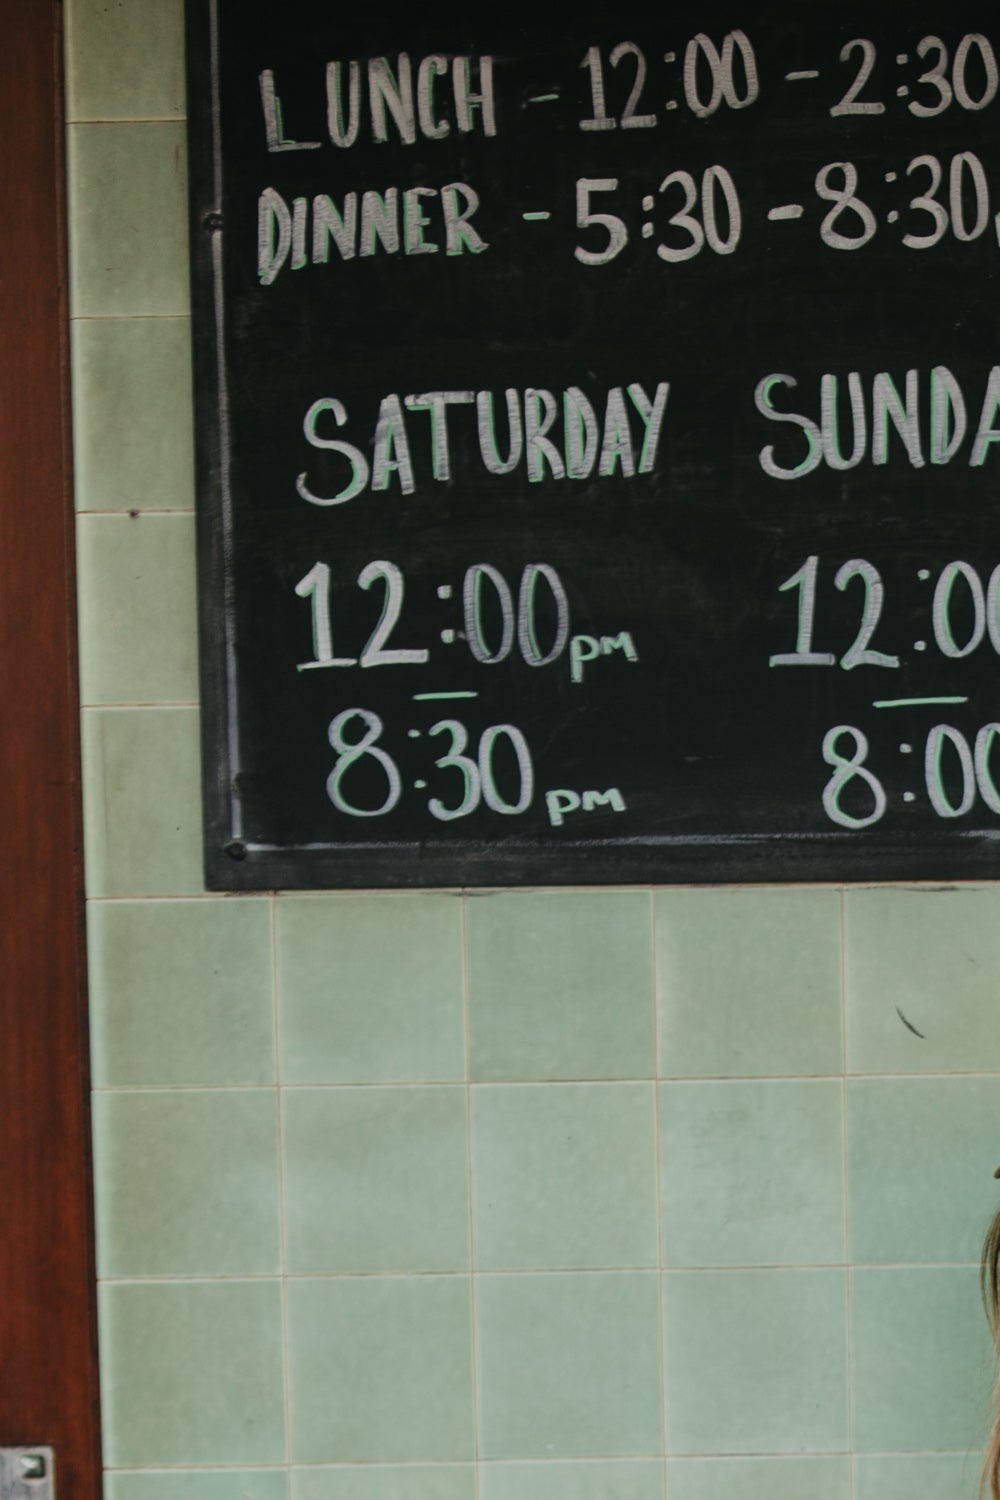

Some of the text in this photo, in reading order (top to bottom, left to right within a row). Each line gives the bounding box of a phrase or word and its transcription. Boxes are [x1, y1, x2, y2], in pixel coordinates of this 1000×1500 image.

[262, 53, 496, 151] LUNCH
[580, 31, 758, 130] 12:00
[258, 183, 488, 285] DINNER
[575, 165, 741, 265] 5:30
[297, 383, 669, 506] SATURDAY
